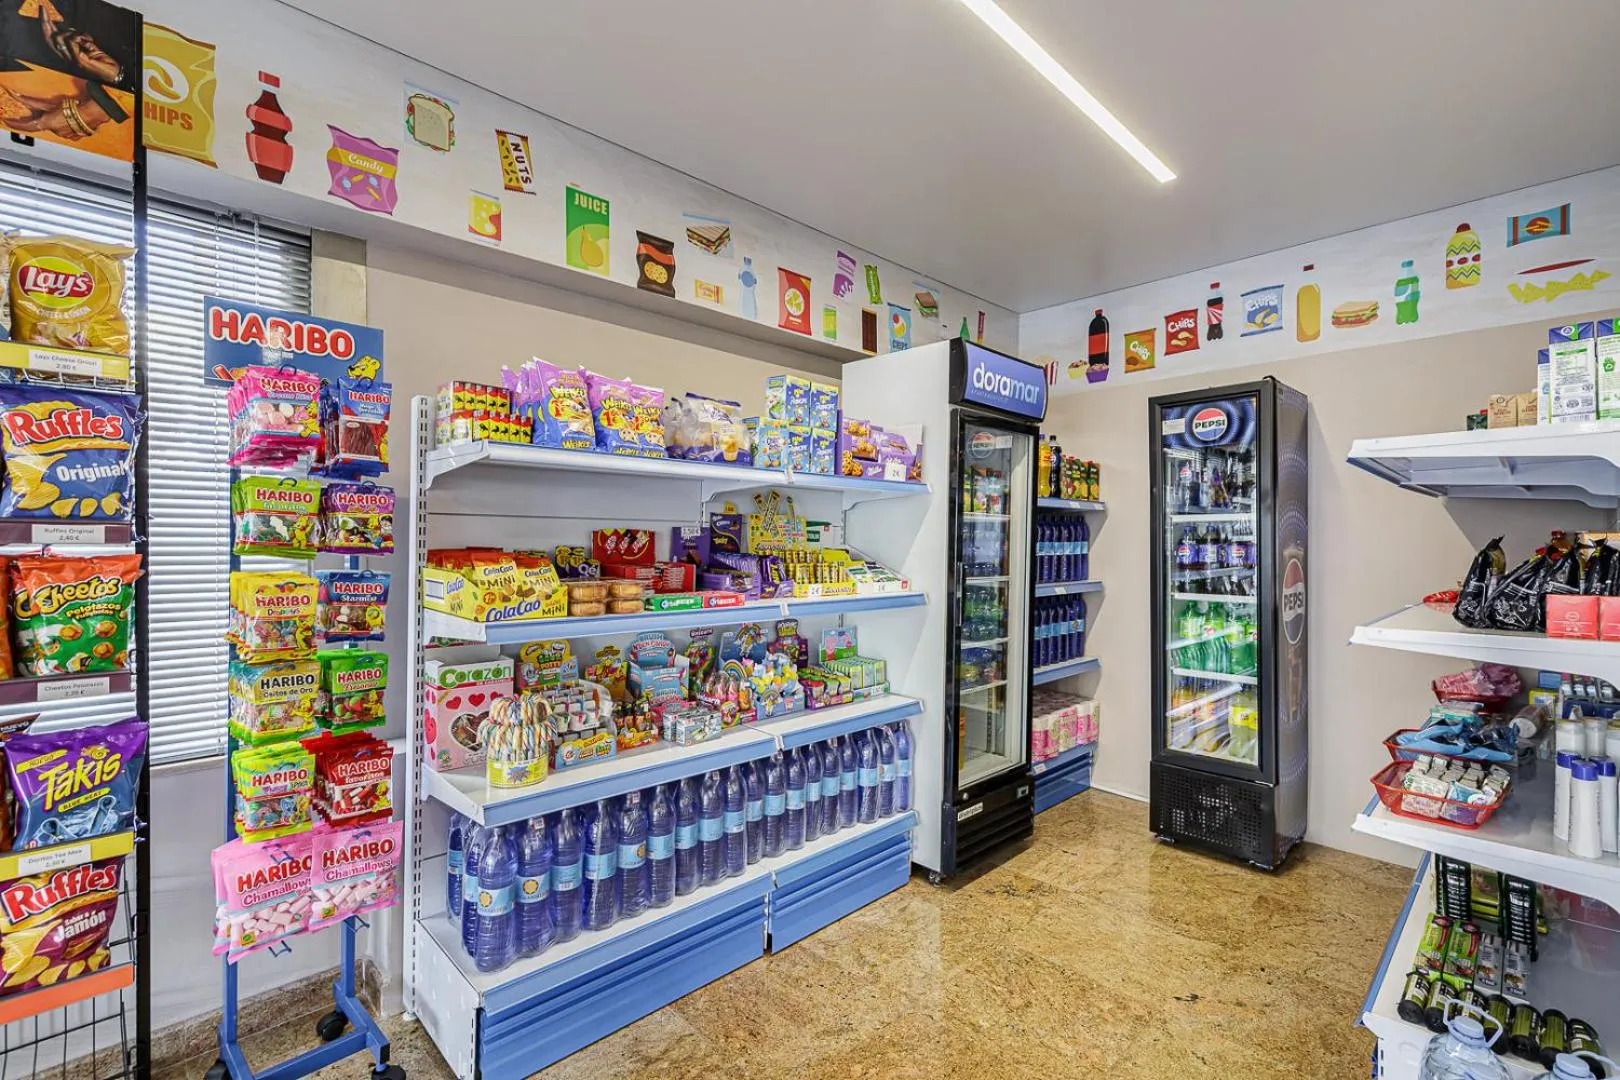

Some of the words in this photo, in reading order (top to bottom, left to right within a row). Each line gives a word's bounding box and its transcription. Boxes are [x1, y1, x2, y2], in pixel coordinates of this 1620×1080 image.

[143, 102, 193, 131] HIPS
[348, 152, 384, 175] Candy
[510, 141, 533, 186] NUTS
[574, 192, 608, 216] JUICE
[210, 307, 354, 360] HARIBO
[260, 377, 317, 394] HARIBO
[972, 361, 1040, 405] doramar
[349, 390, 391, 405] HARIBO
[2, 408, 124, 446] Ruffles
[1194, 418, 1226, 430] PEPSI
[55, 460, 127, 483] Original
[256, 488, 314, 504] HARIBO
[337, 493, 389, 506] HARIBO
[483, 564, 514, 577] ColaCao
[35, 576, 120, 616] Cheetos
[334, 582, 384, 595] HARIBO
[255, 595, 312, 608] HARIBO
[485, 600, 542, 623] ColaCao
[1284, 591, 1305, 613] PEPSI
[260, 674, 315, 690] HARIBO
[337, 669, 382, 684] HARIBO
[440, 664, 512, 688] Corazón
[263, 689, 288, 698] Ositos
[300, 686, 313, 694] Oro
[252, 769, 308, 787] HARIBO
[339, 759, 390, 777] HARIBO
[38, 753, 122, 811] Takis
[322, 838, 395, 869] HARIBO
[237, 855, 312, 893] HARIBO
[324, 860, 392, 882] Chamallows
[2, 863, 118, 924] Ruffles
[54, 909, 107, 943] Jamón
